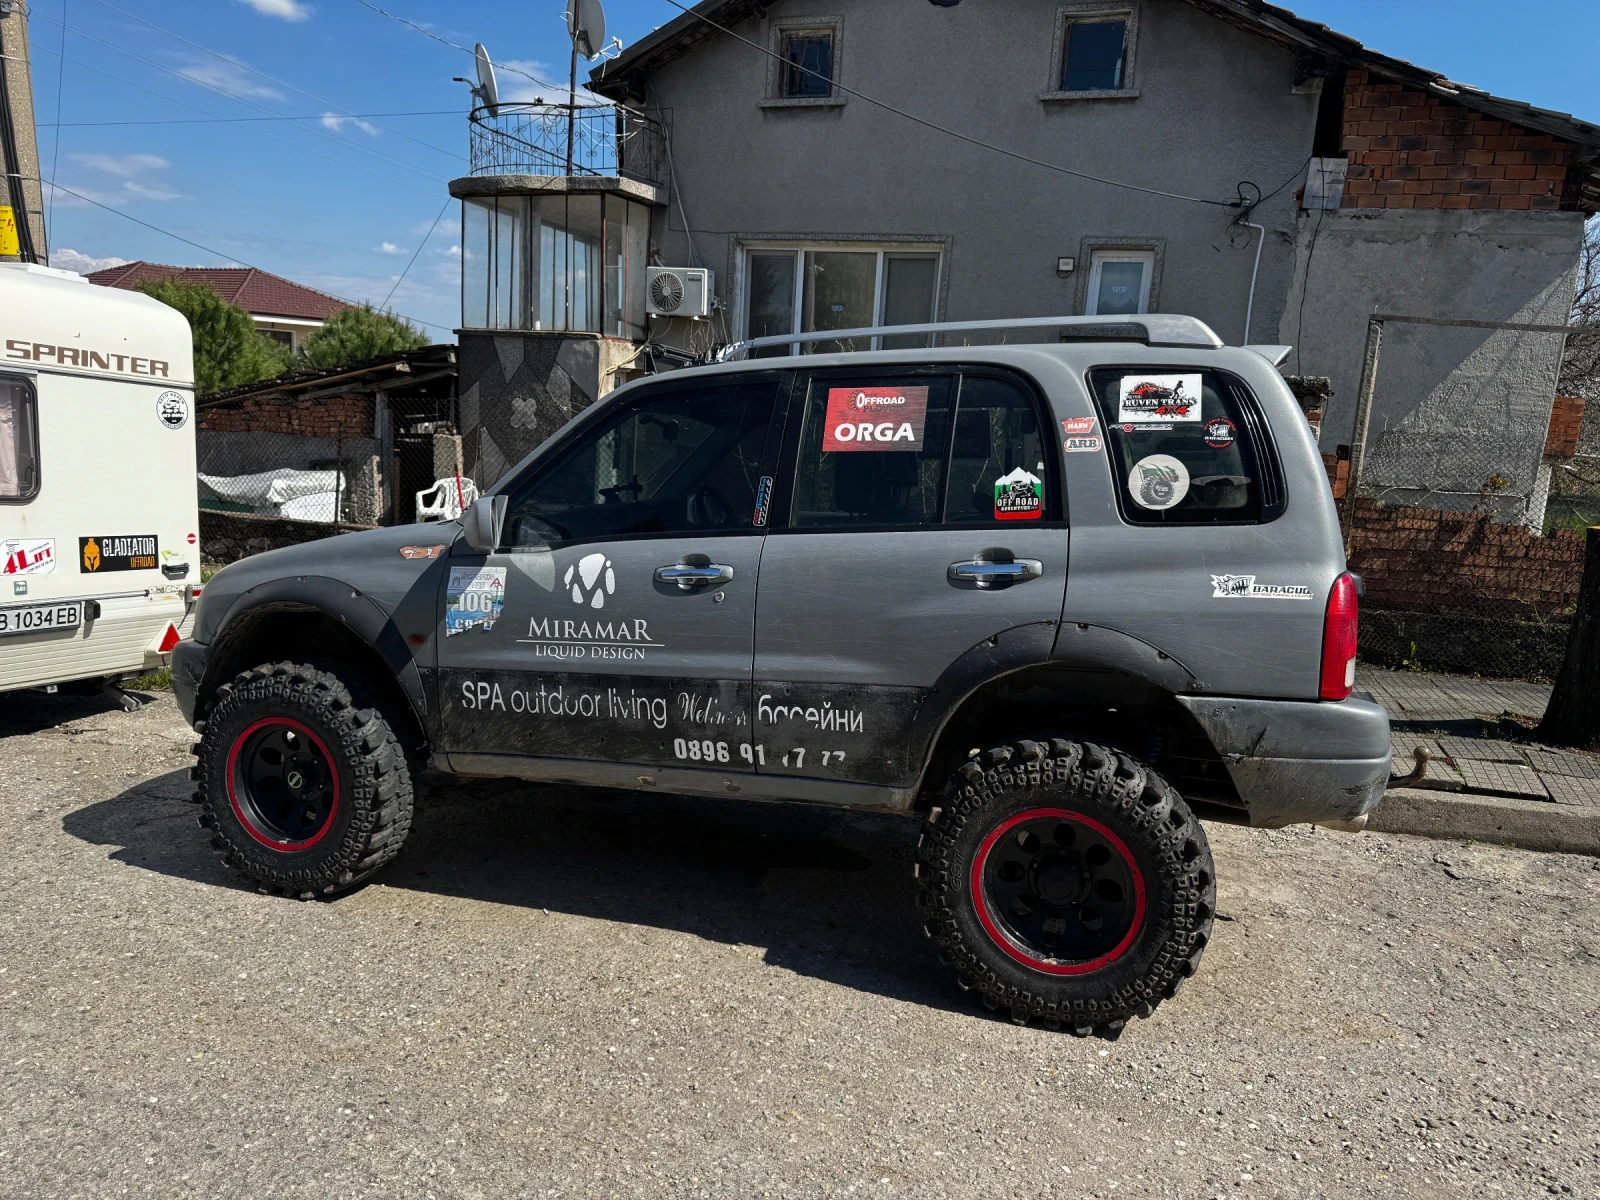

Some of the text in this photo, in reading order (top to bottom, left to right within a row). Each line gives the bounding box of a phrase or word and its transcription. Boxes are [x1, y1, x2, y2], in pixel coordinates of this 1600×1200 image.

[6, 339, 169, 377] SPRINTER
[856, 393, 905, 408] OFFROAD
[834, 422, 915, 442] ORGA
[1068, 439, 1097, 448] ARB
[997, 497, 1039, 507] OFF ROAD
[103, 537, 155, 557] GLADIATOR
[130, 555, 155, 568] OFFROAD
[1253, 585, 1312, 594] BARACUD
[457, 592, 493, 612] 106
[15, 608, 53, 629] 1034
[57, 607, 77, 625] EB
[528, 616, 653, 641] MIRAMAR
[535, 644, 646, 660] LIQUID DESIGN
[462, 680, 506, 711] SPA
[511, 684, 601, 717] outdoor
[608, 687, 667, 729] living
[674, 738, 730, 763] 0898
